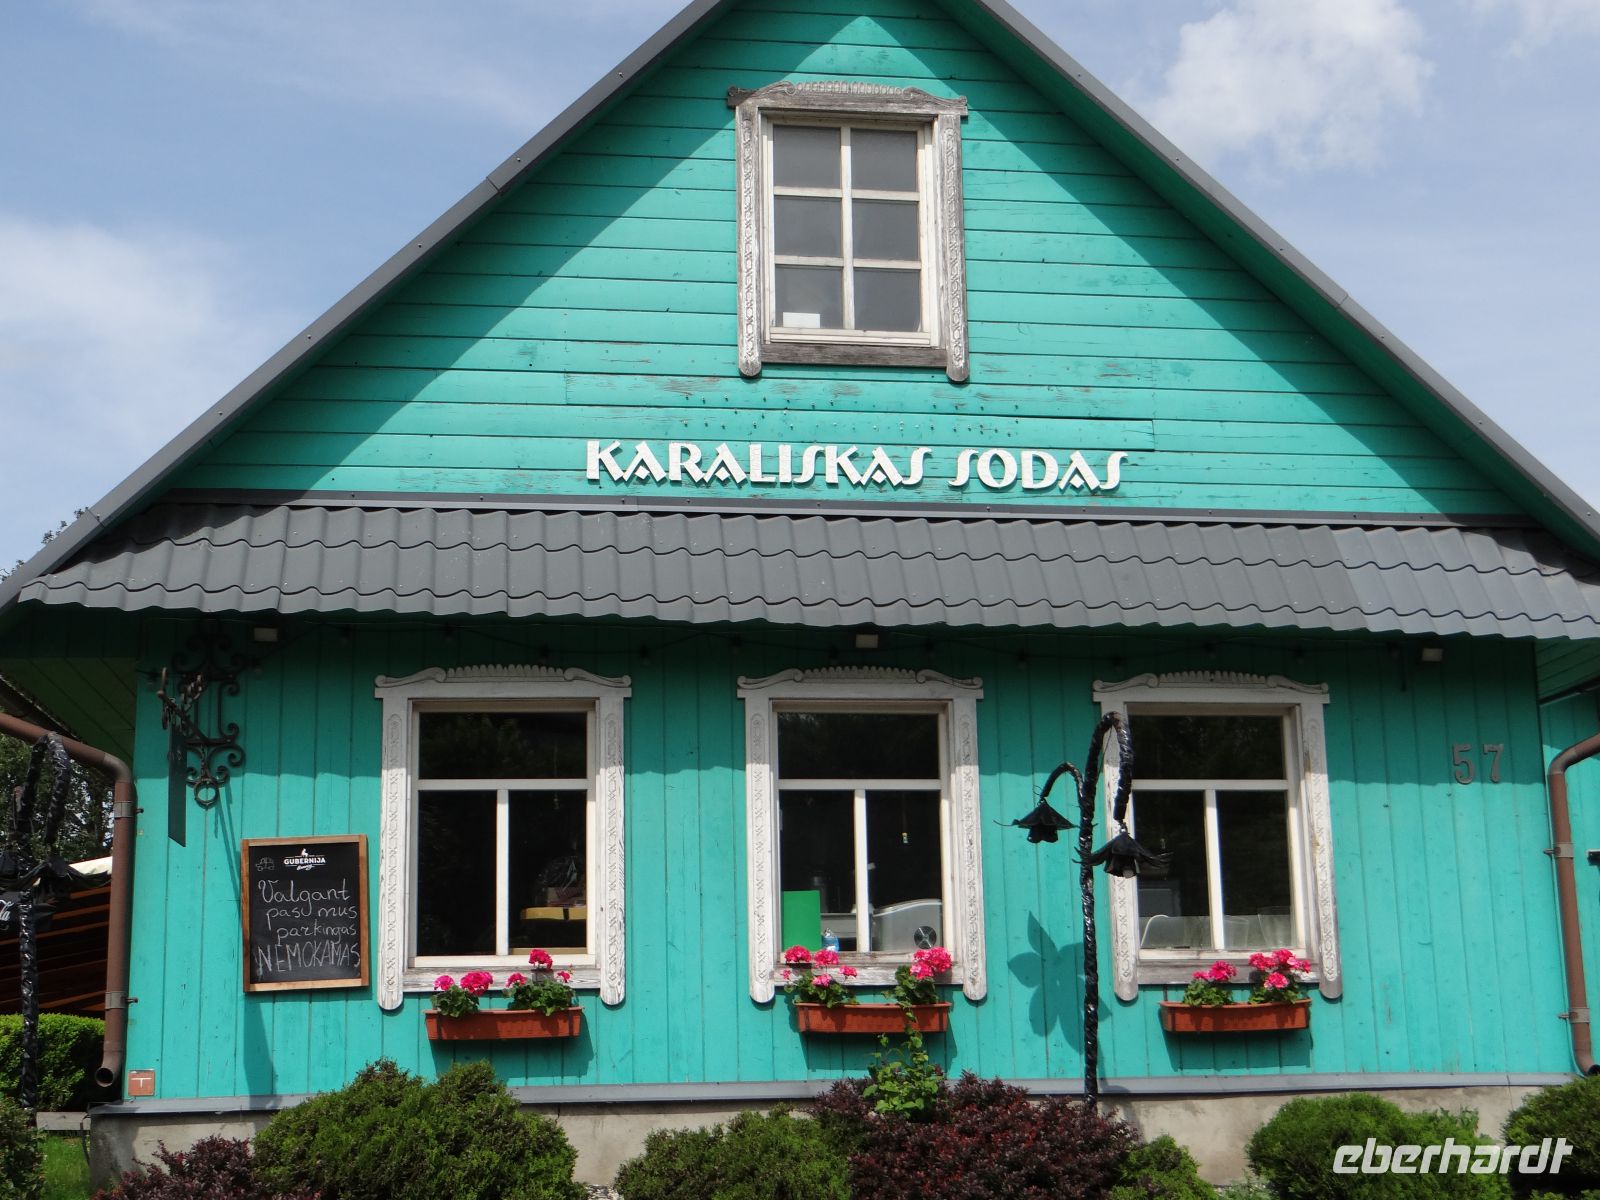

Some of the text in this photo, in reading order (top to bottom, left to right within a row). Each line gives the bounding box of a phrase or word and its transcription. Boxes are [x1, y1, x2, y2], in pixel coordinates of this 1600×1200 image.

[586, 439, 1128, 492] KARALISKAS SODAS
[1452, 743, 1504, 785] 57
[283, 857, 326, 865] GUBERNIJA
[258, 878, 350, 916] Valgant
[266, 905, 358, 931] pas mus
[276, 919, 357, 947] parkingas
[257, 940, 361, 976] NEMOKAMAS
